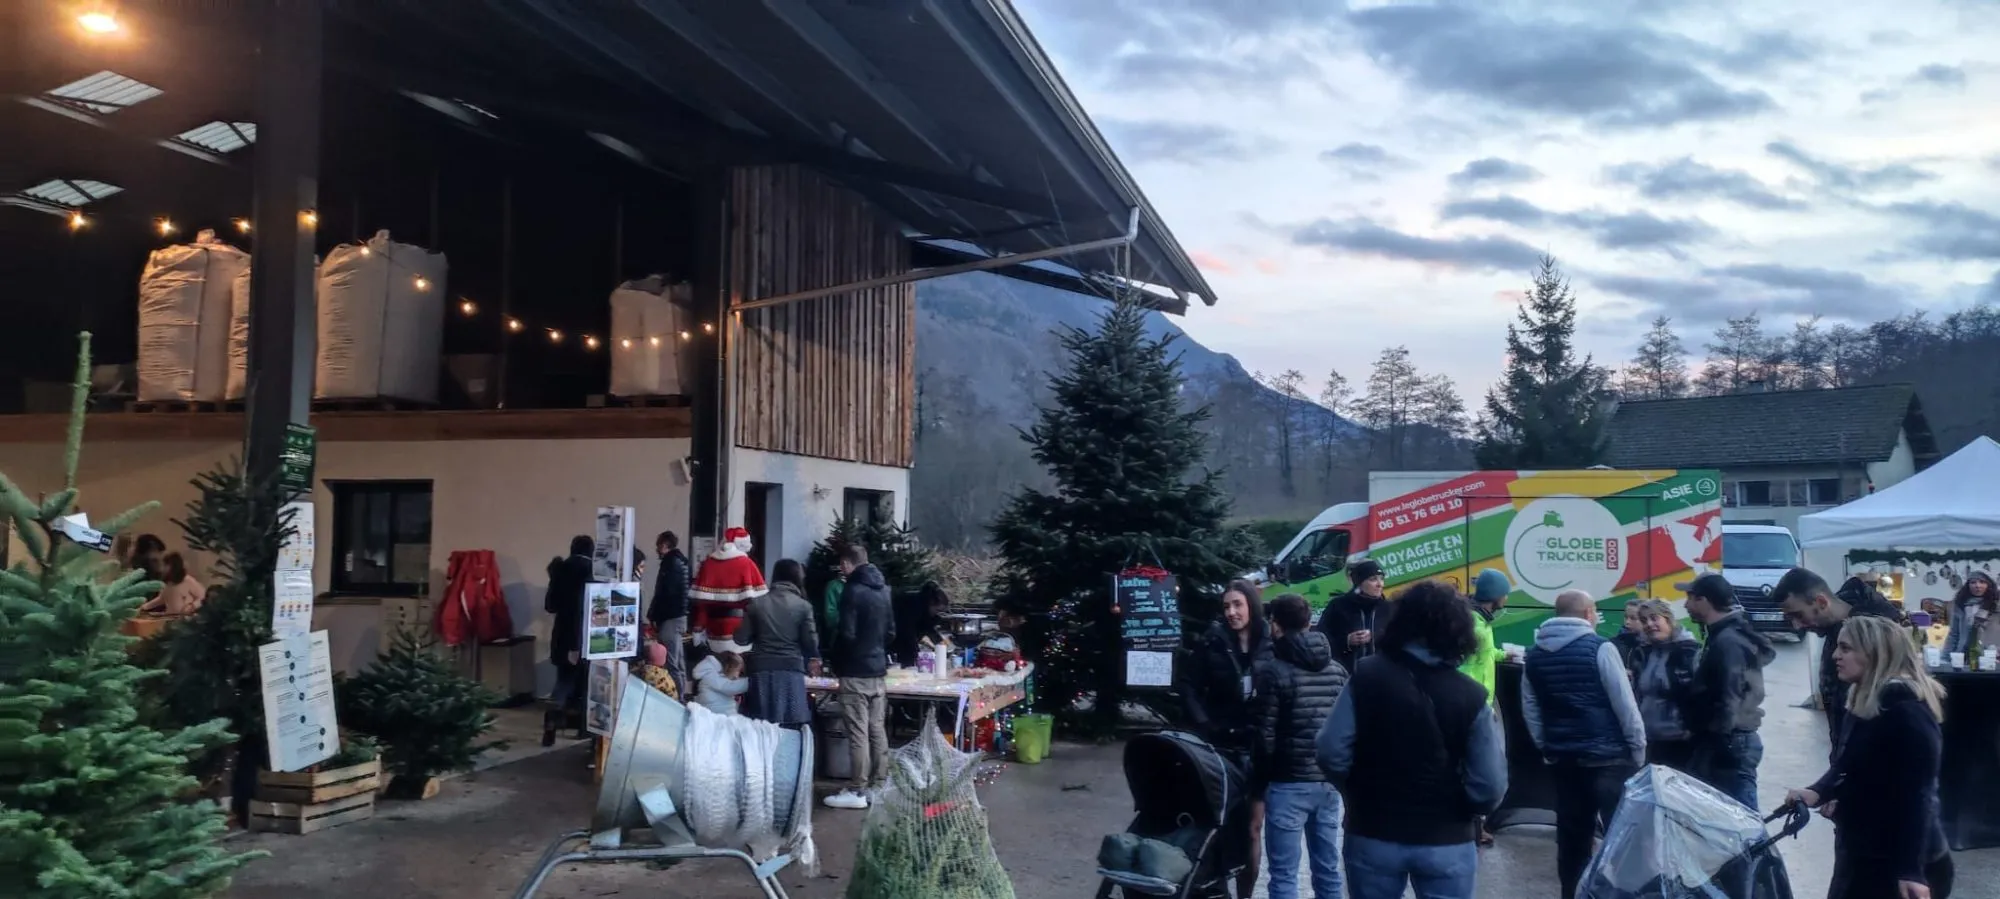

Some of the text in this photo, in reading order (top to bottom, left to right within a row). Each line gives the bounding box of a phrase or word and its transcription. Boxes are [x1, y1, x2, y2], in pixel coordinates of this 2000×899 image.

[1378, 480, 1485, 517] www.leglobetrucker.com
[1662, 483, 1693, 501] ASIE
[1378, 498, 1463, 531] 06 51 76 64 10
[1377, 533, 1464, 567] VOYAGEZ EN
[1546, 537, 1604, 549] GLOBE
[1607, 540, 1617, 569] FOOD
[1405, 549, 1454, 572] BOUCHÉE
[1536, 551, 1605, 562] TRUCKER
